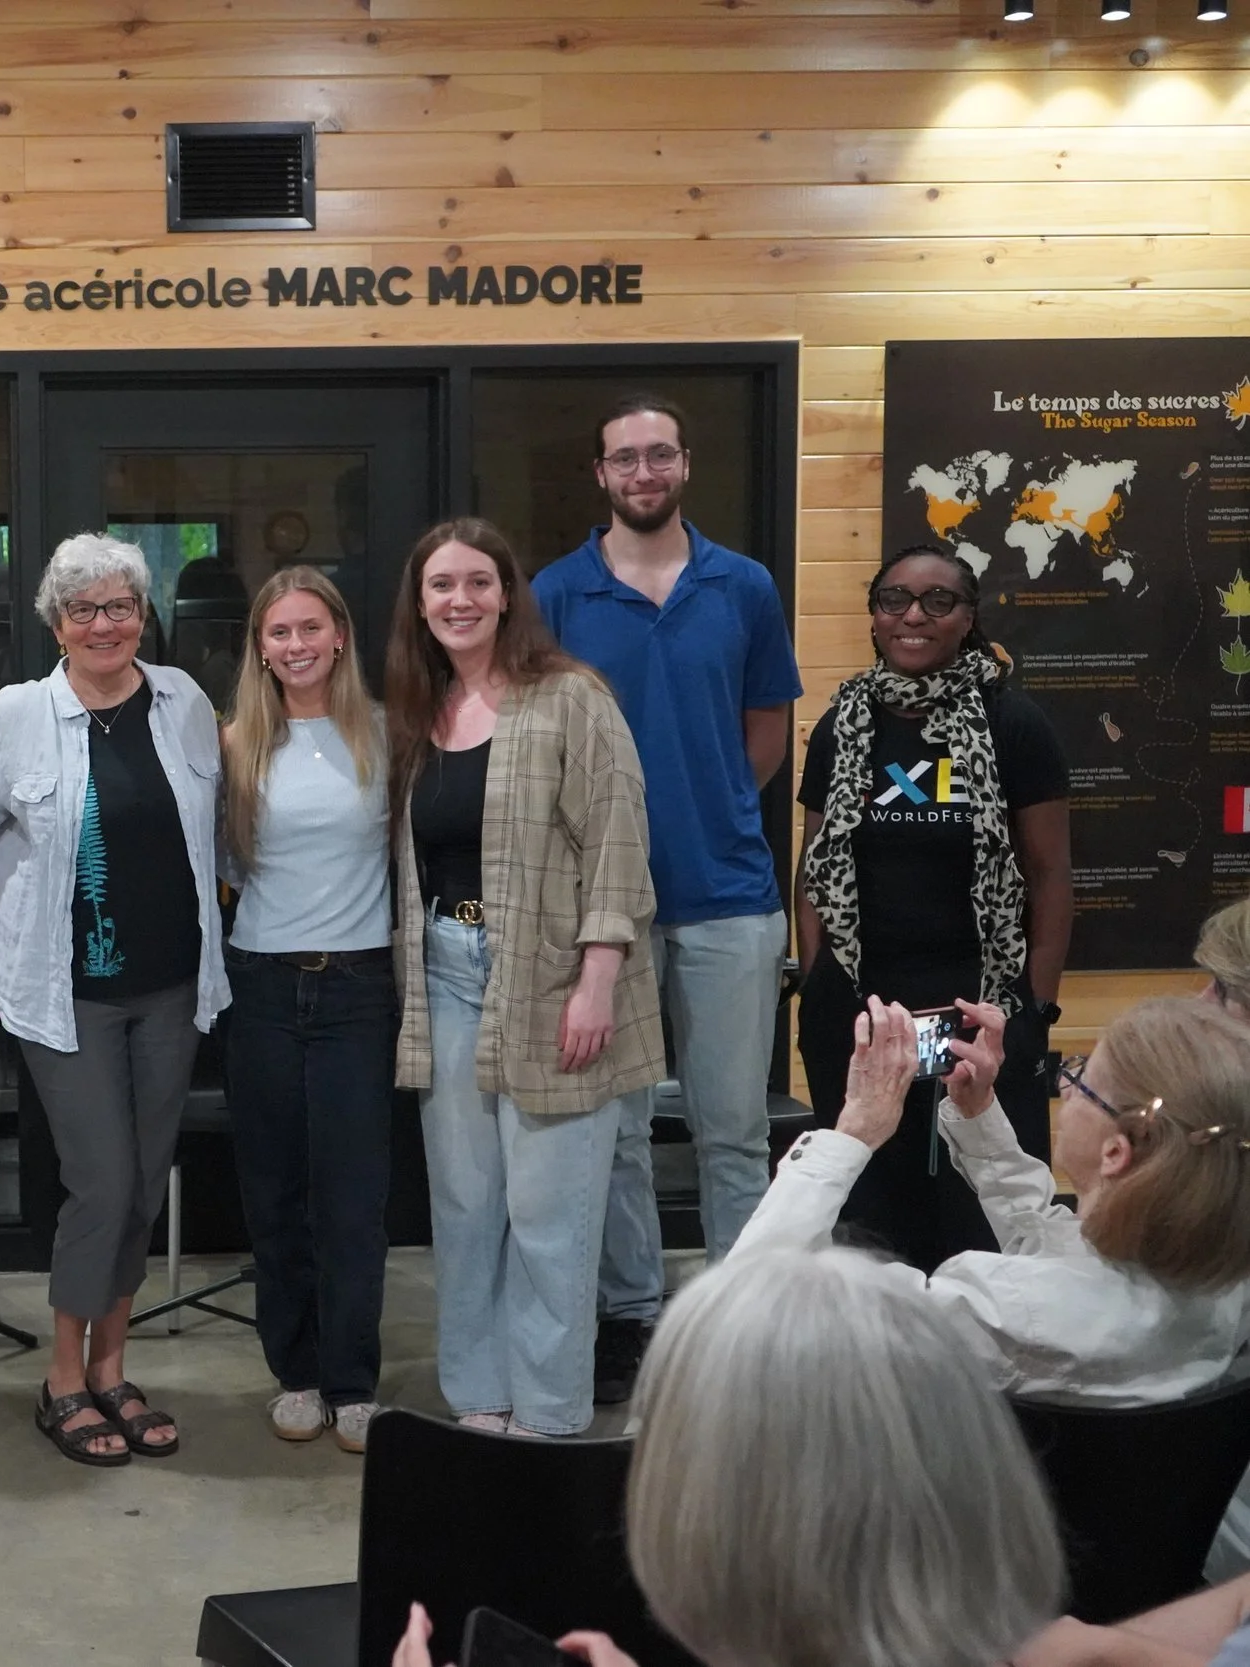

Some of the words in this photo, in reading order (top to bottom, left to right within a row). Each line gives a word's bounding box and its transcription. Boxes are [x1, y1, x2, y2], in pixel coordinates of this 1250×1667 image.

[23, 265, 252, 313] acéricole
[266, 265, 413, 307] MARC
[427, 260, 645, 307] MADORE
[993, 390, 1025, 412] Le
[1029, 392, 1101, 418] temps
[1105, 390, 1142, 411] des
[1147, 395, 1221, 410] sucres
[1041, 411, 1076, 429] The
[1080, 411, 1132, 433] Sugar
[1136, 411, 1197, 428] Season
[870, 809, 974, 823] WORLDFES
